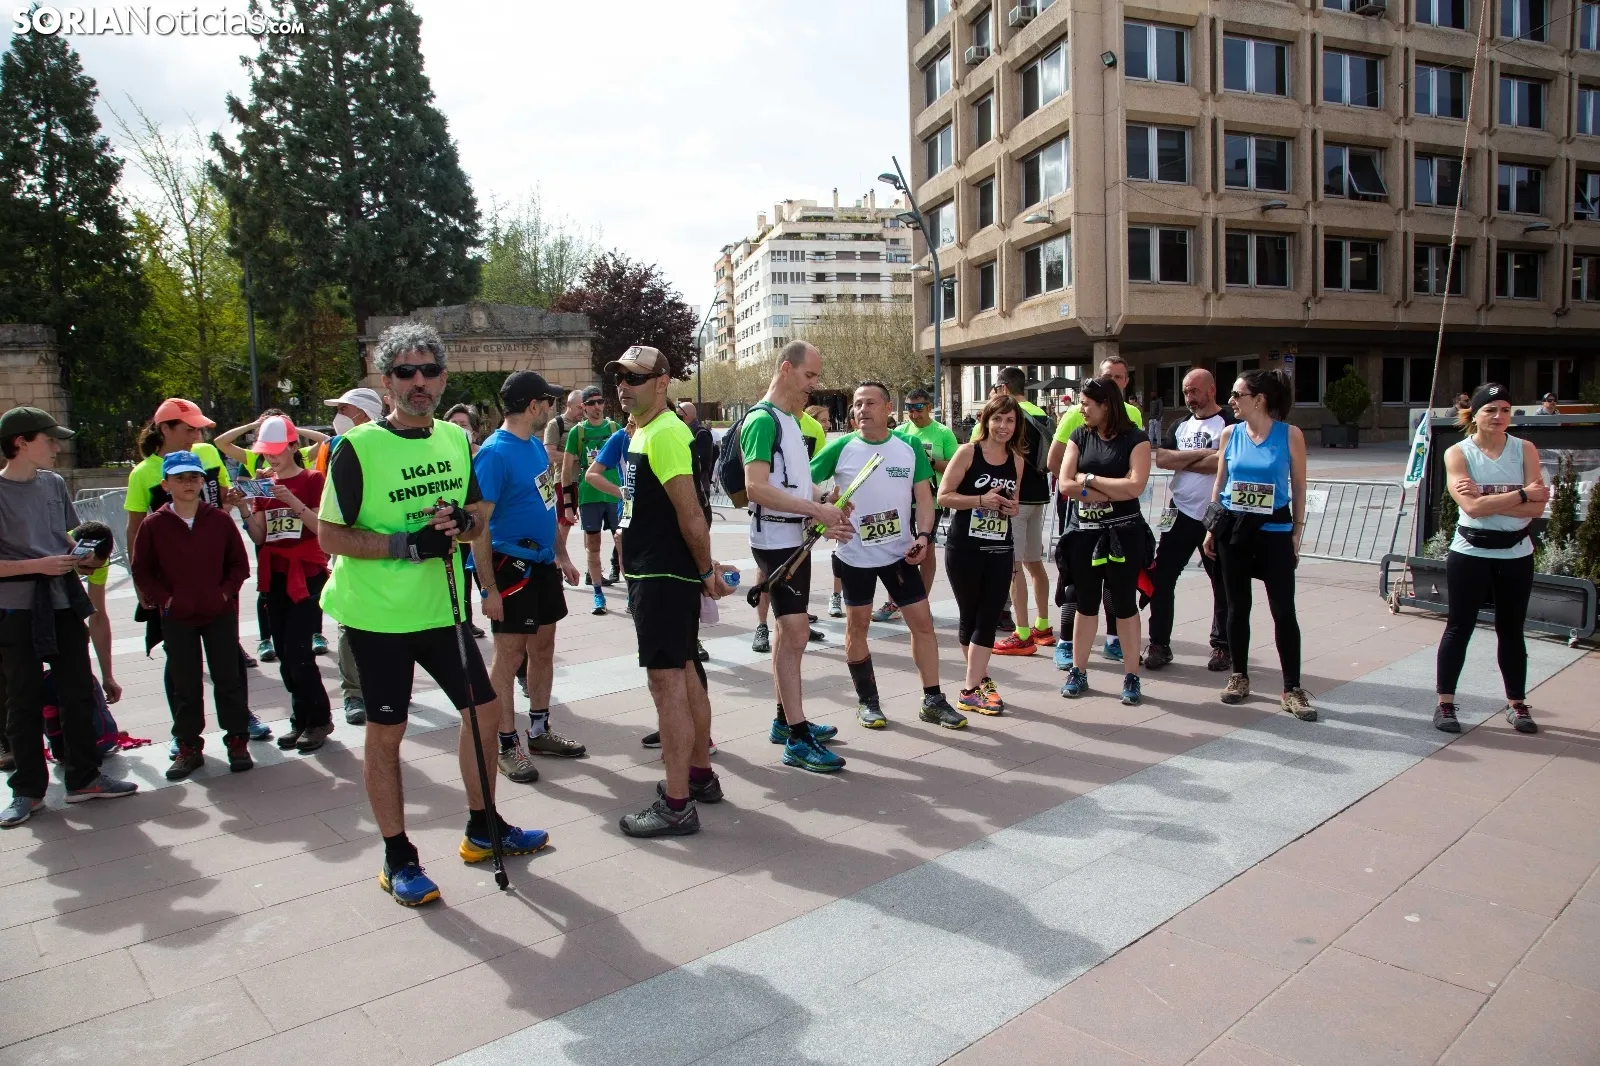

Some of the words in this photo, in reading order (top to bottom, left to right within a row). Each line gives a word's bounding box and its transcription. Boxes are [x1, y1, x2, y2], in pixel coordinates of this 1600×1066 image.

[483, 343, 539, 353] CERVANTES
[400, 463, 436, 480] LIGA
[437, 460, 452, 474] DE
[388, 477, 463, 503] SENDERISMO
[990, 478, 1016, 490] asics
[1237, 492, 1266, 506] 207
[272, 518, 294, 533] 213
[866, 521, 895, 539] 203
[977, 519, 1003, 532] 201
